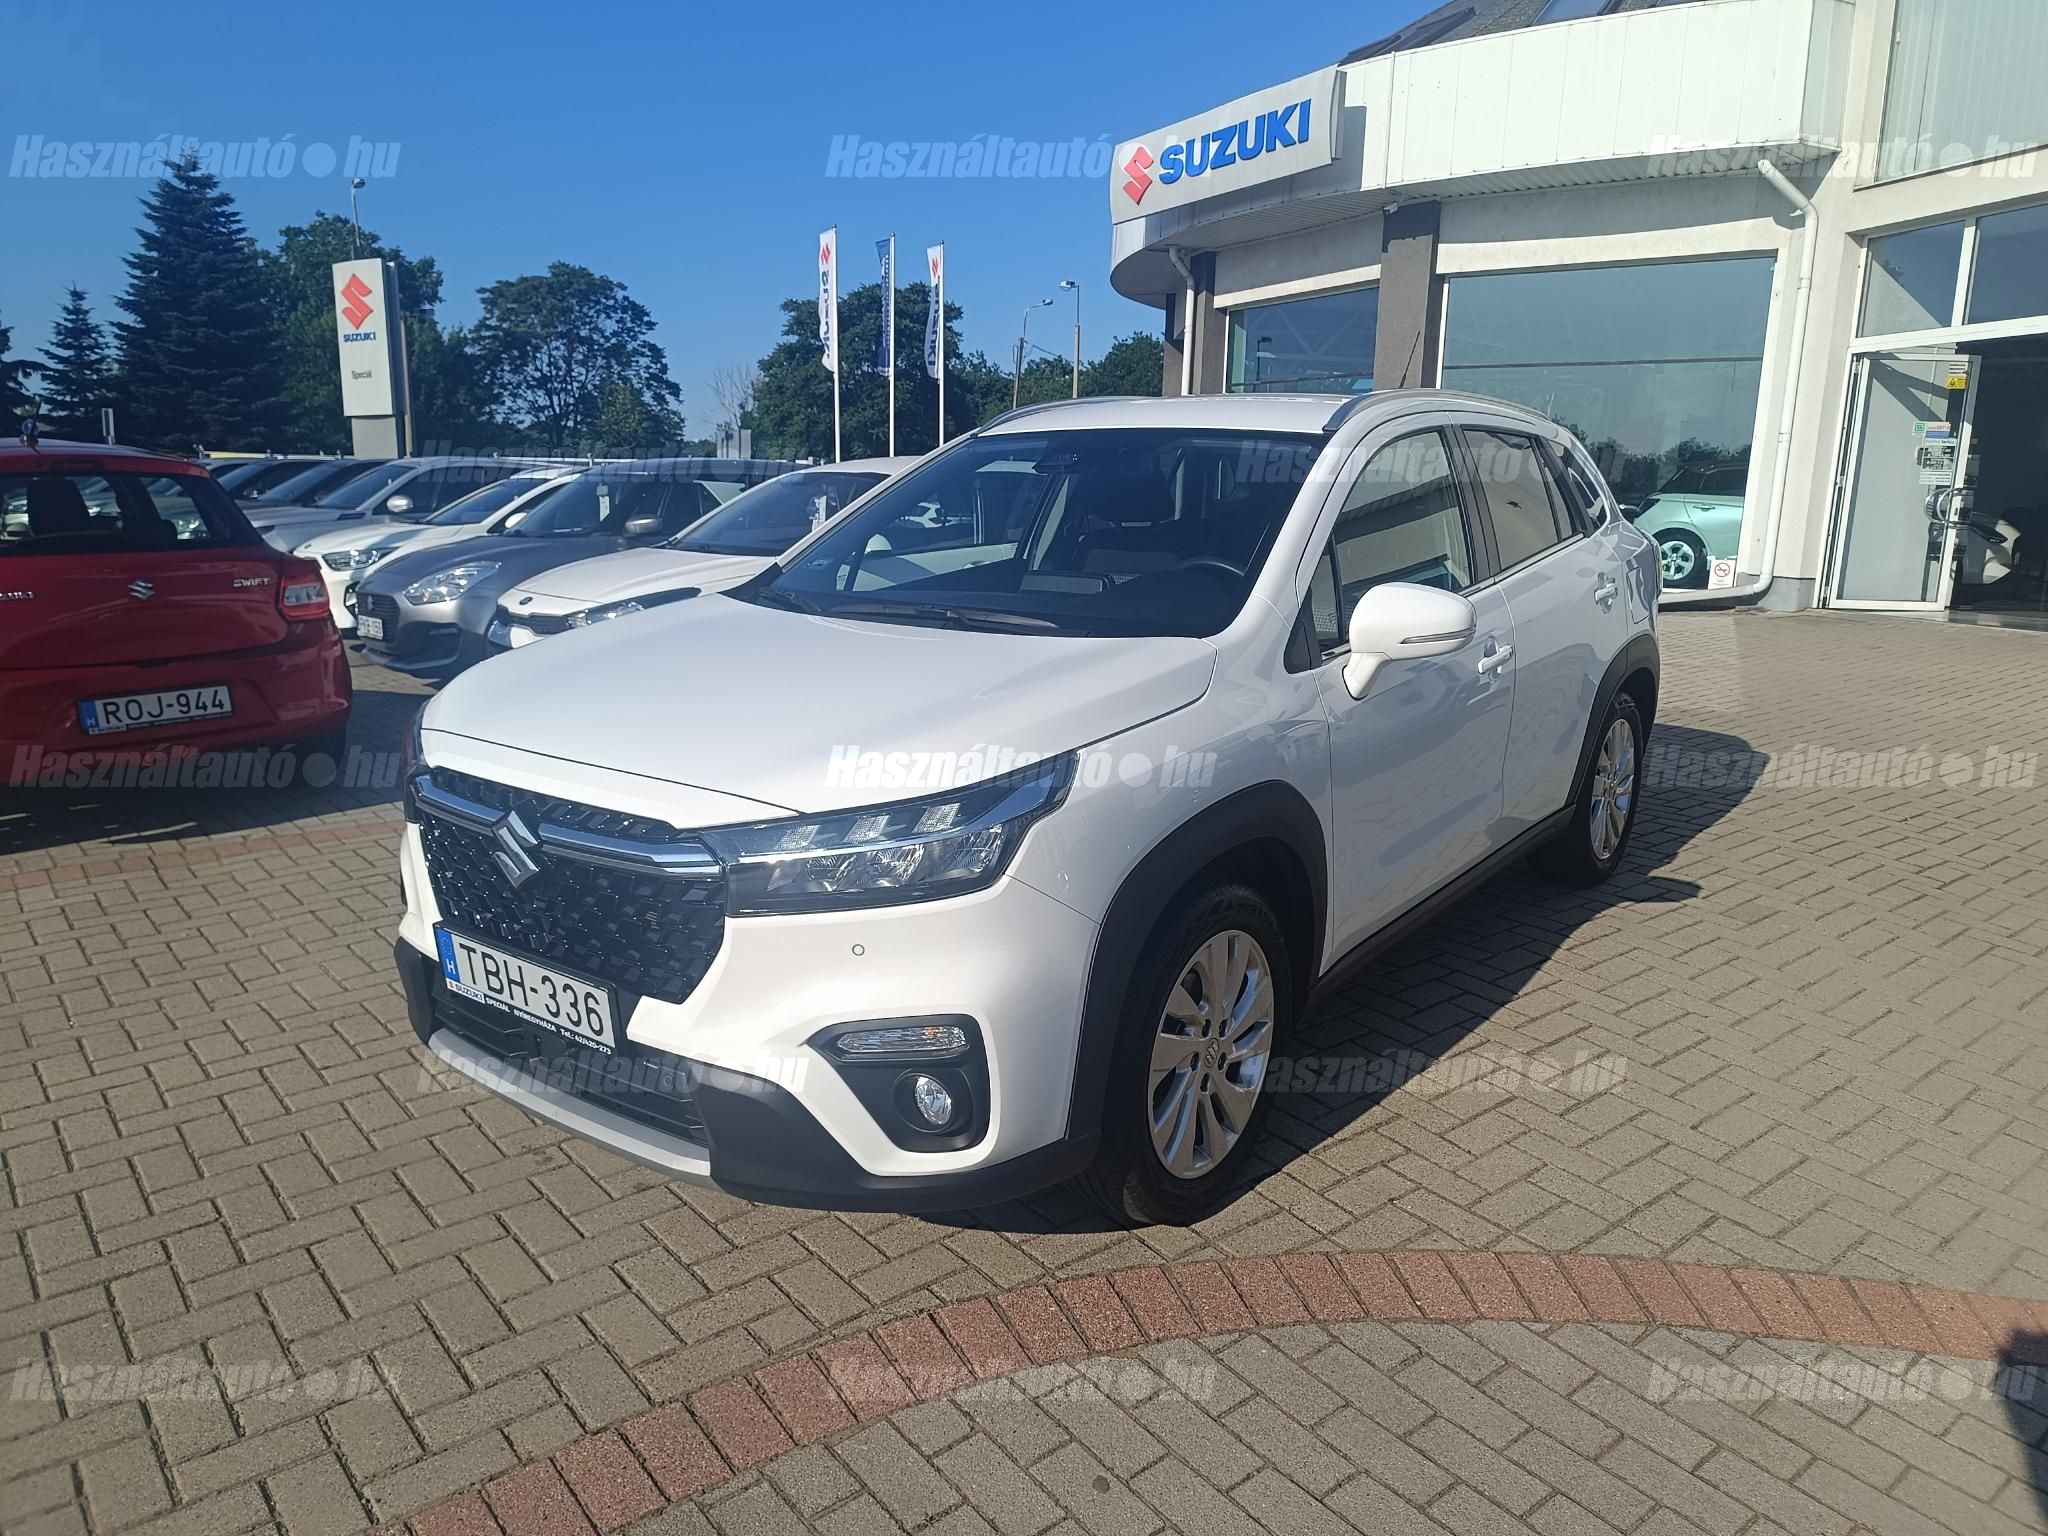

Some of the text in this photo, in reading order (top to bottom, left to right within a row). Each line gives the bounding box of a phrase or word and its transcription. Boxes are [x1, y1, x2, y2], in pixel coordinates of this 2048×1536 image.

[1159, 98, 1312, 185] SUZUKI
[343, 332, 376, 343] SUZUKI
[233, 577, 272, 588] SWIFT
[102, 689, 225, 725] ROJ-944
[447, 958, 456, 975] H
[459, 942, 605, 1037] TBH-336
